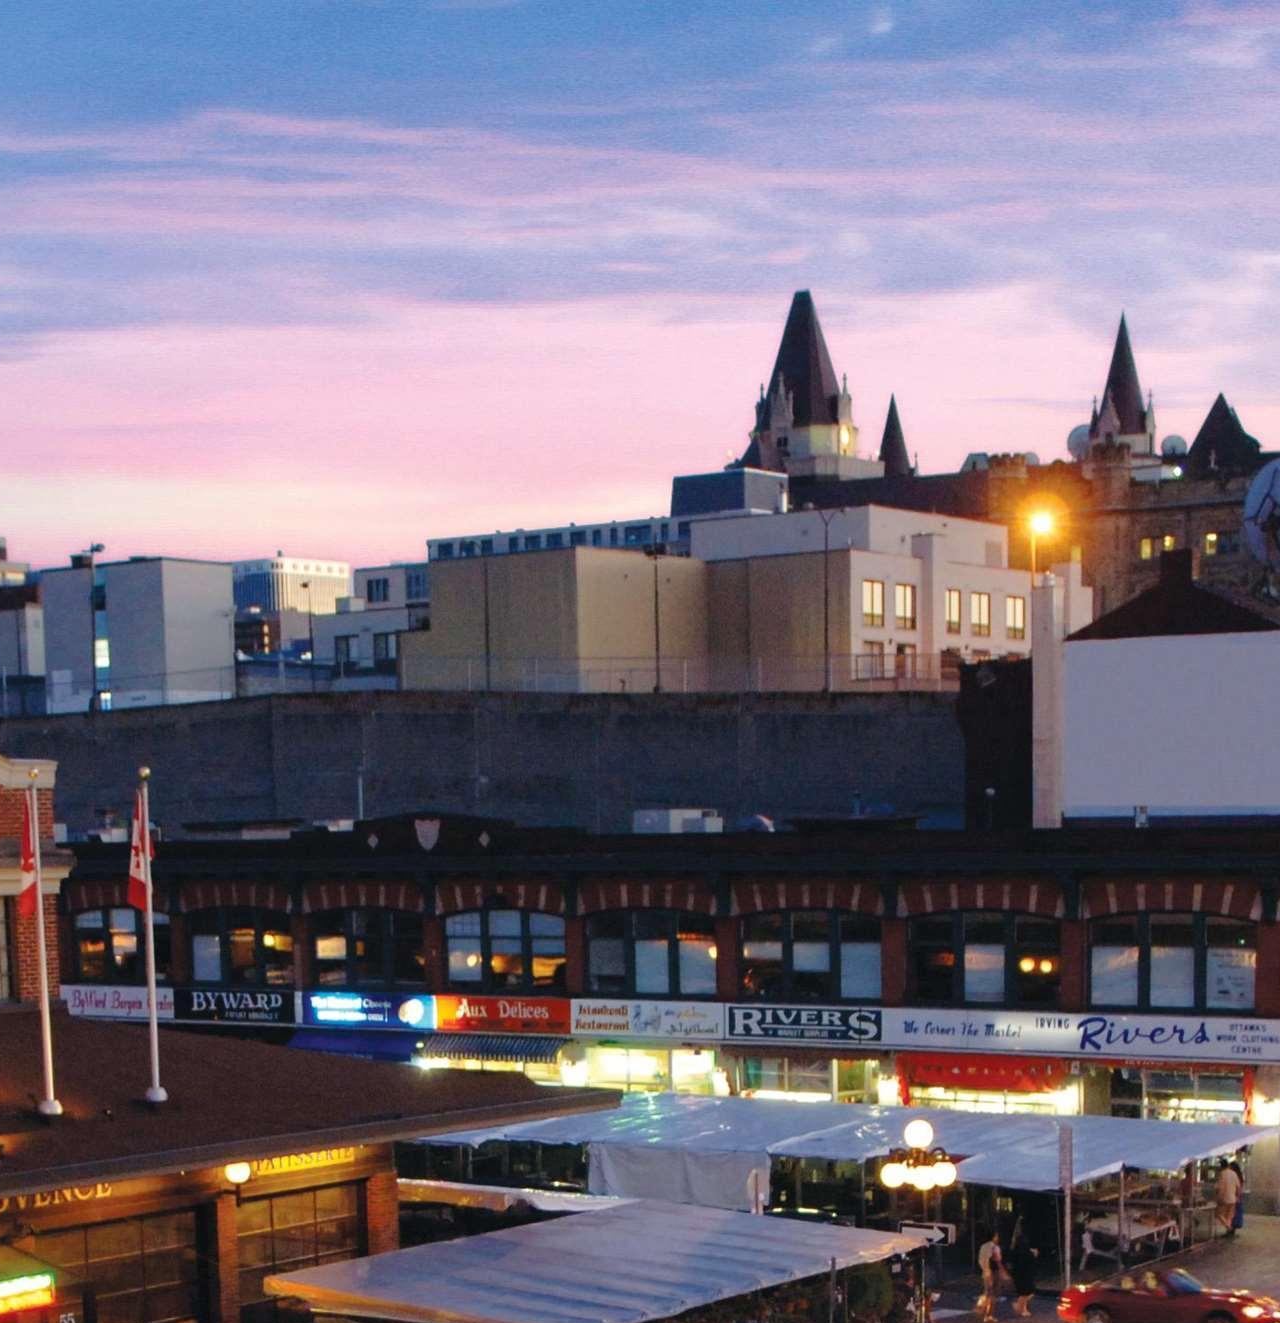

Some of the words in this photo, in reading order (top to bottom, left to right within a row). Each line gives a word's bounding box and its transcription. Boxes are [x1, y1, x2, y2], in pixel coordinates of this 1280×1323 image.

[191, 991, 282, 1012] BYWARD
[456, 998, 488, 1018] Aux
[732, 1008, 878, 1040] RIVERS
[904, 1019, 919, 1035] We
[960, 1022, 978, 1036] The
[984, 1023, 1021, 1039] Market
[1035, 1016, 1070, 1030] IRVING
[1077, 1016, 1209, 1050] Rivers
